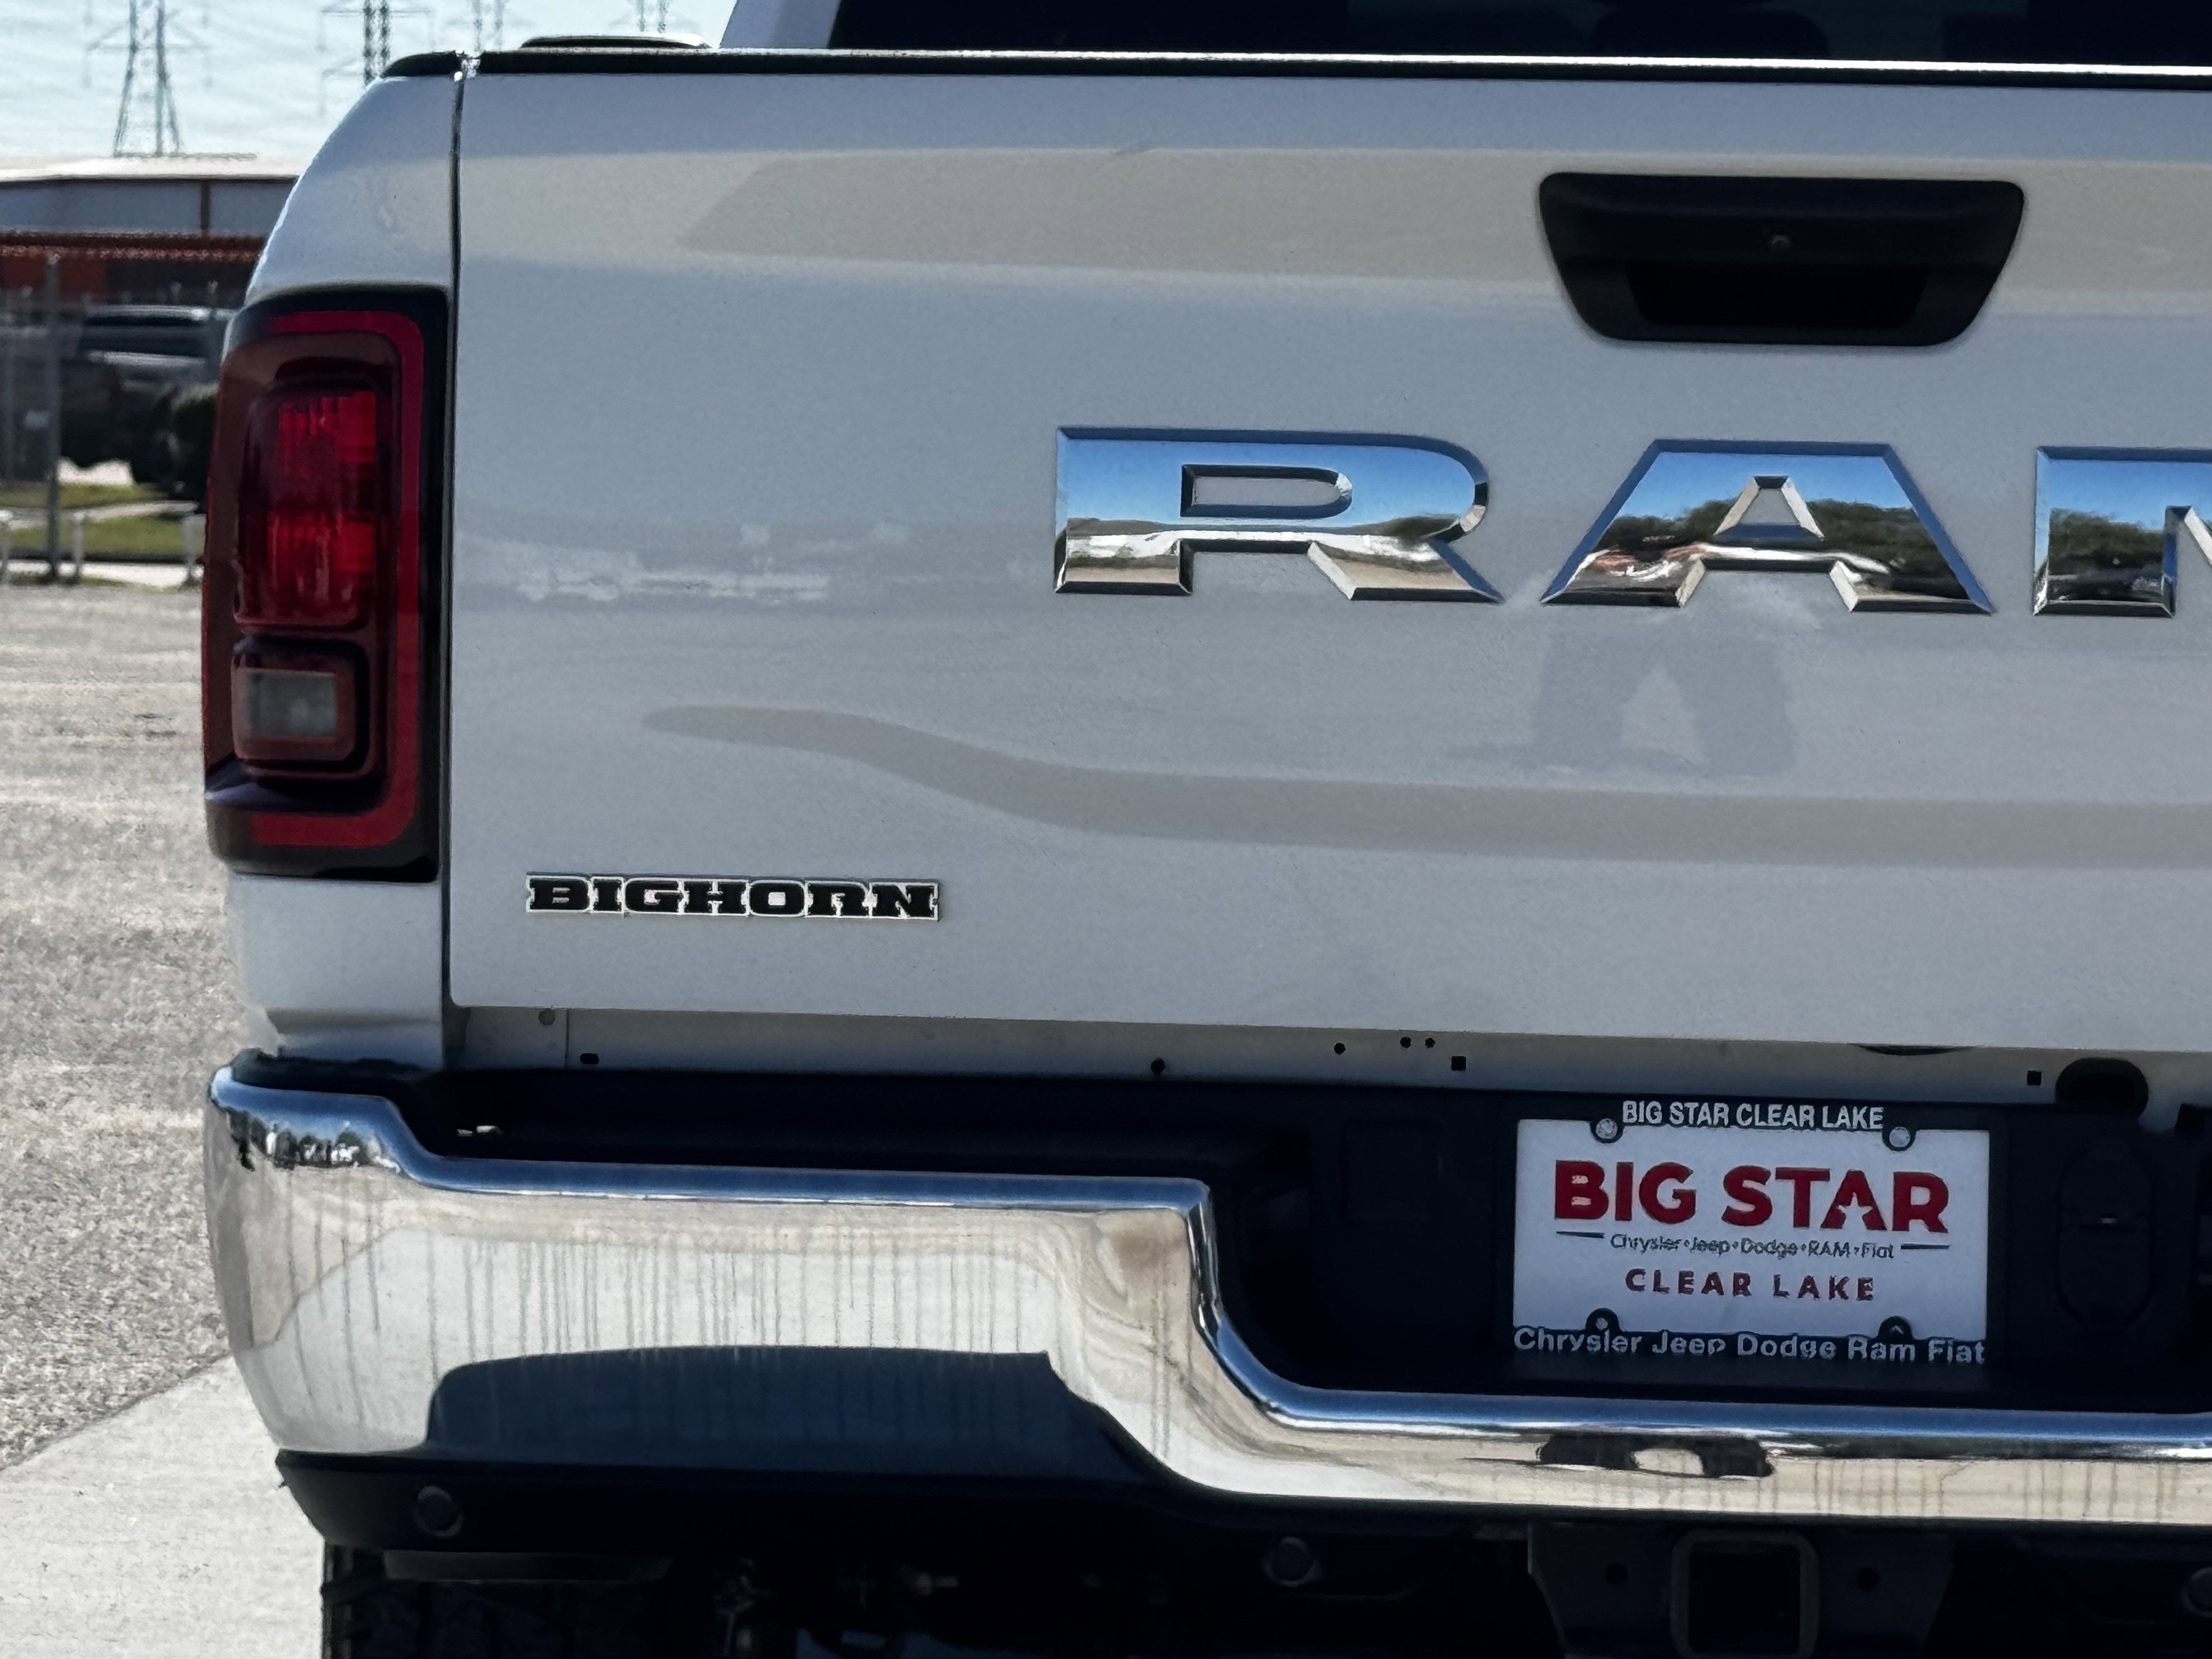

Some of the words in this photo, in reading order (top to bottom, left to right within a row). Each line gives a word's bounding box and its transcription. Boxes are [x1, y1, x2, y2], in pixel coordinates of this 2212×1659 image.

[526, 873, 939, 921] BIGHORN
[1622, 1100, 1662, 1124] BIG
[1669, 1102, 1730, 1126] STAR
[1736, 1103, 1815, 1128] CLEAR
[1822, 1105, 1884, 1130] LAKE
[1554, 1159, 1697, 1225] BIG
[1720, 1164, 1949, 1234] STAR
[1625, 1268, 1753, 1297] CLEAR
[1772, 1273, 1874, 1301] LAKE
[1514, 1327, 1643, 1353] Chrysler
[1652, 1329, 1726, 1357] Jeep
[1737, 1333, 1837, 1359] Dodge
[1847, 1336, 1915, 1362] Ram
[1927, 1339, 1985, 1365] Fiat
